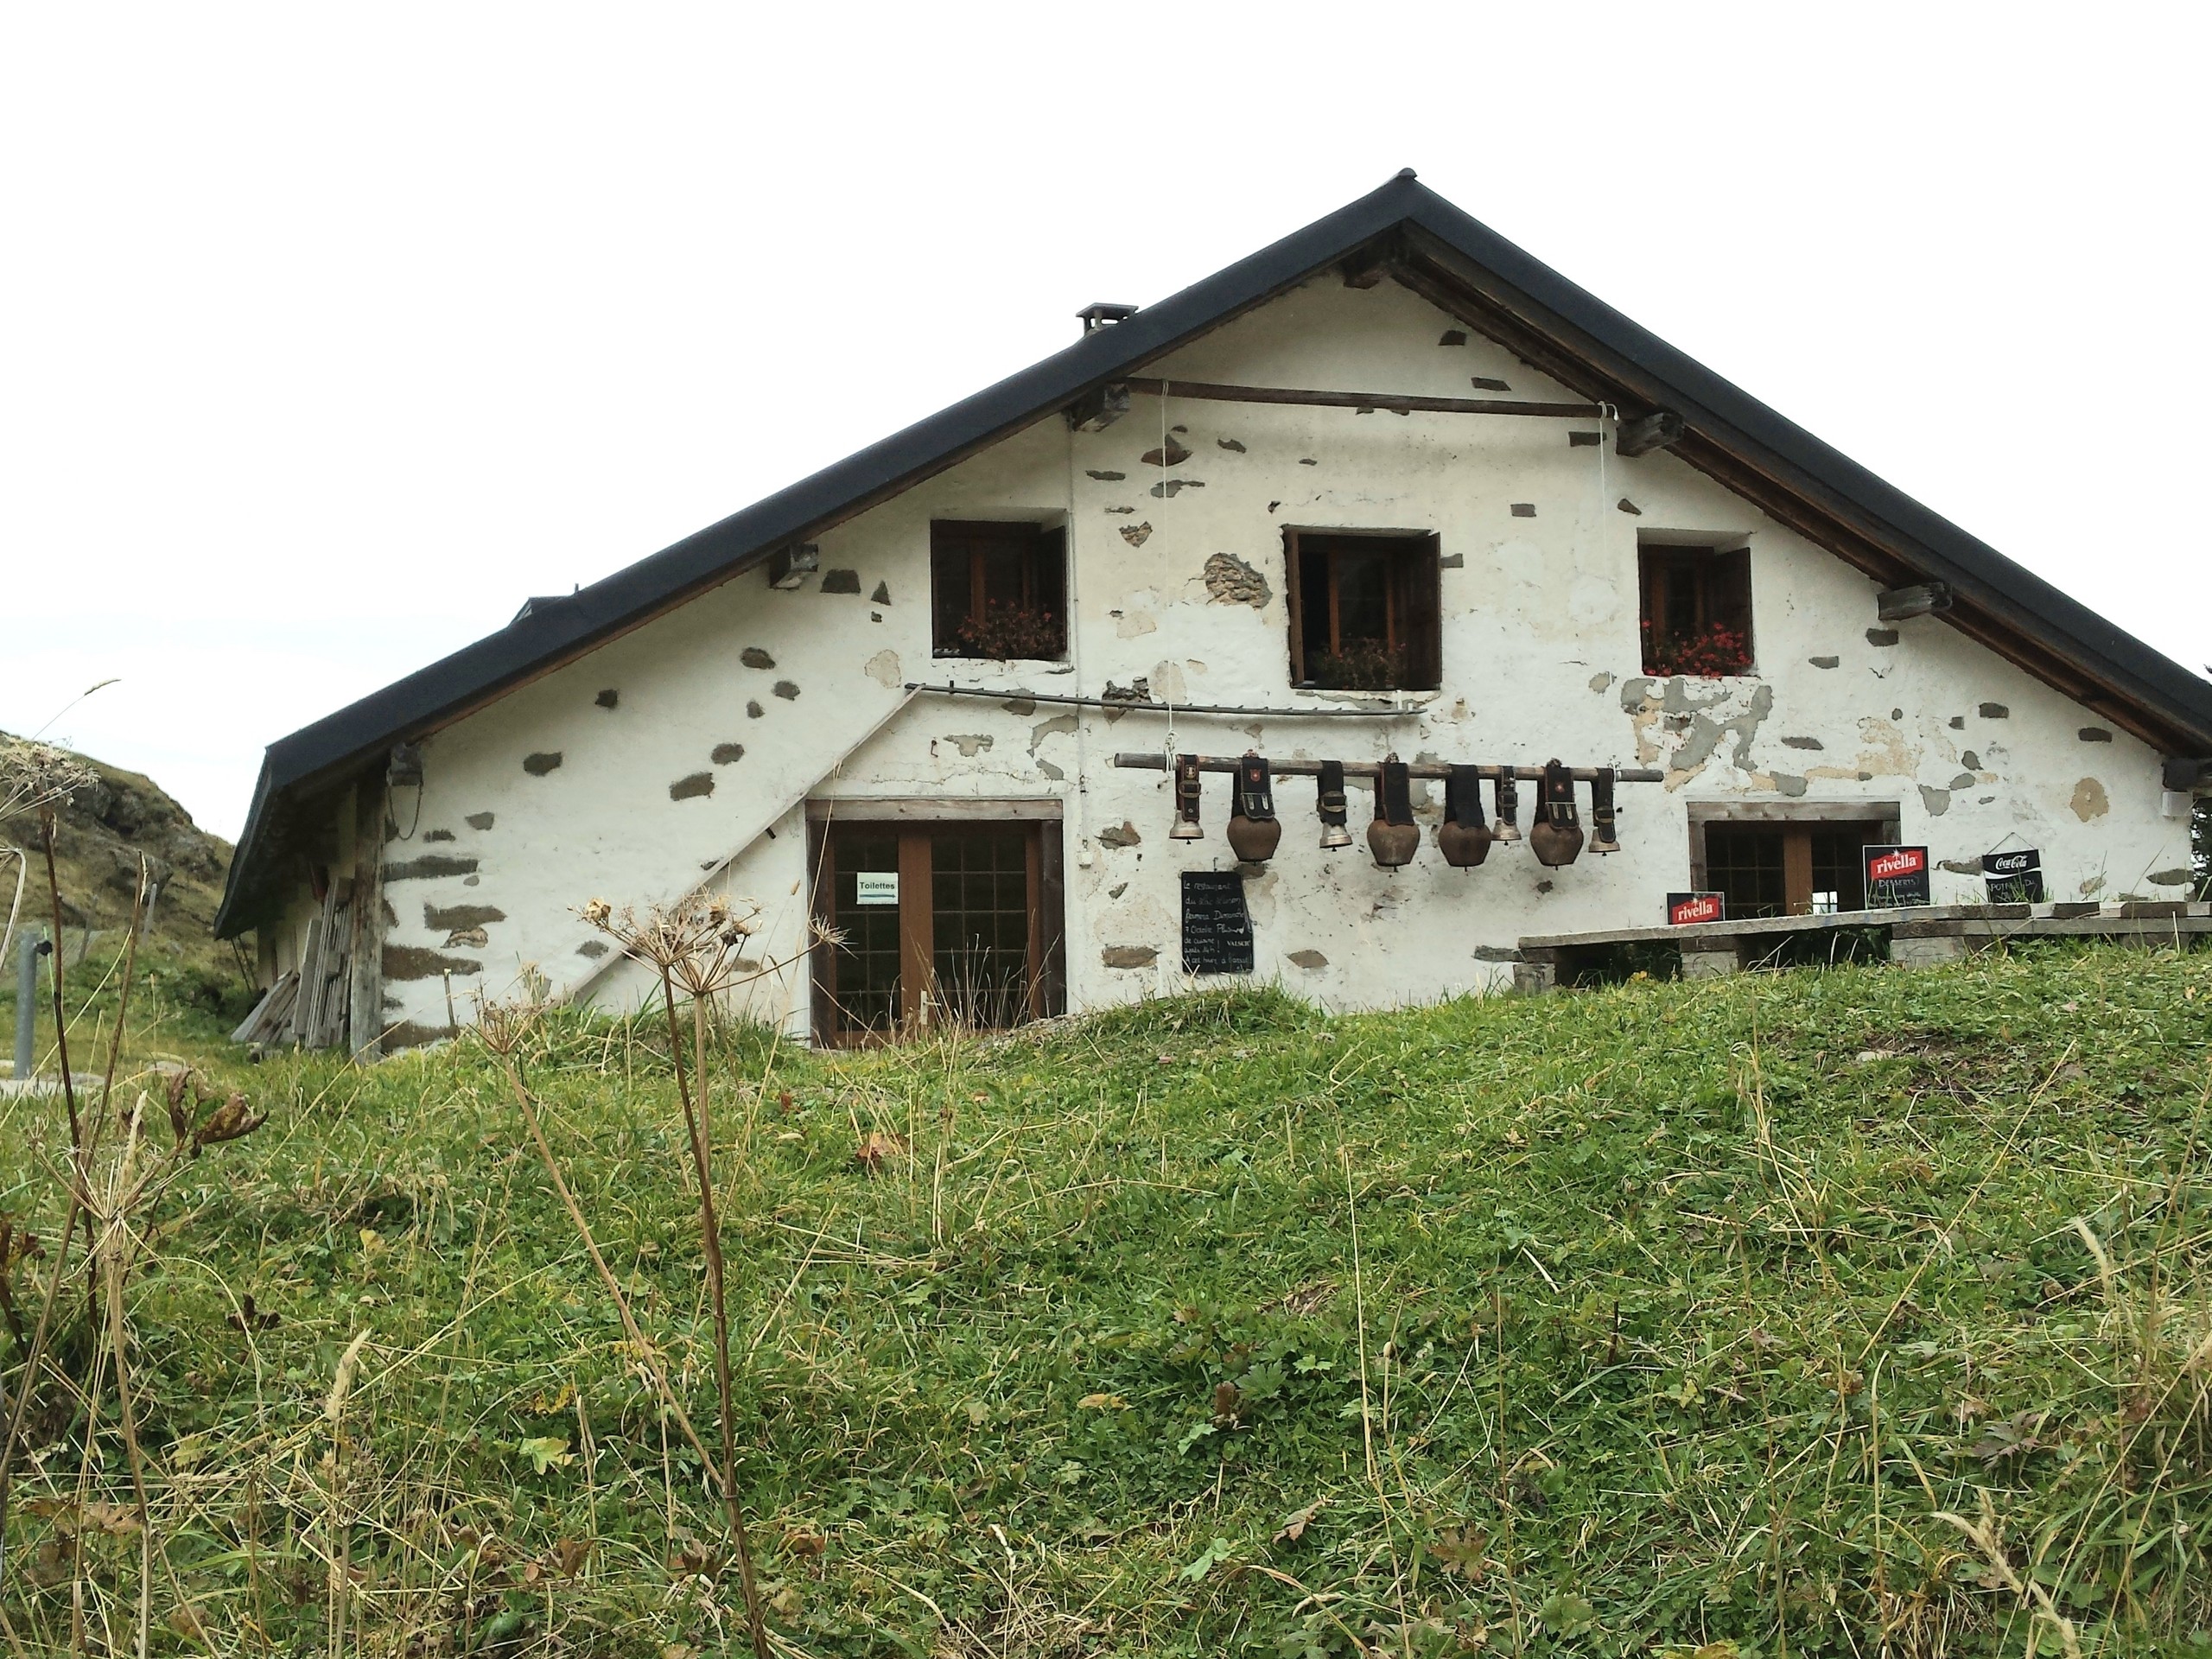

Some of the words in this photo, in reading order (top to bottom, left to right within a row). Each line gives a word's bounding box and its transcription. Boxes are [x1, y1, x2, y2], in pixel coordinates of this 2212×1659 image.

[1876, 854, 1916, 874] rivella
[859, 881, 895, 890] Toilettes
[1677, 900, 1713, 921] rivella
